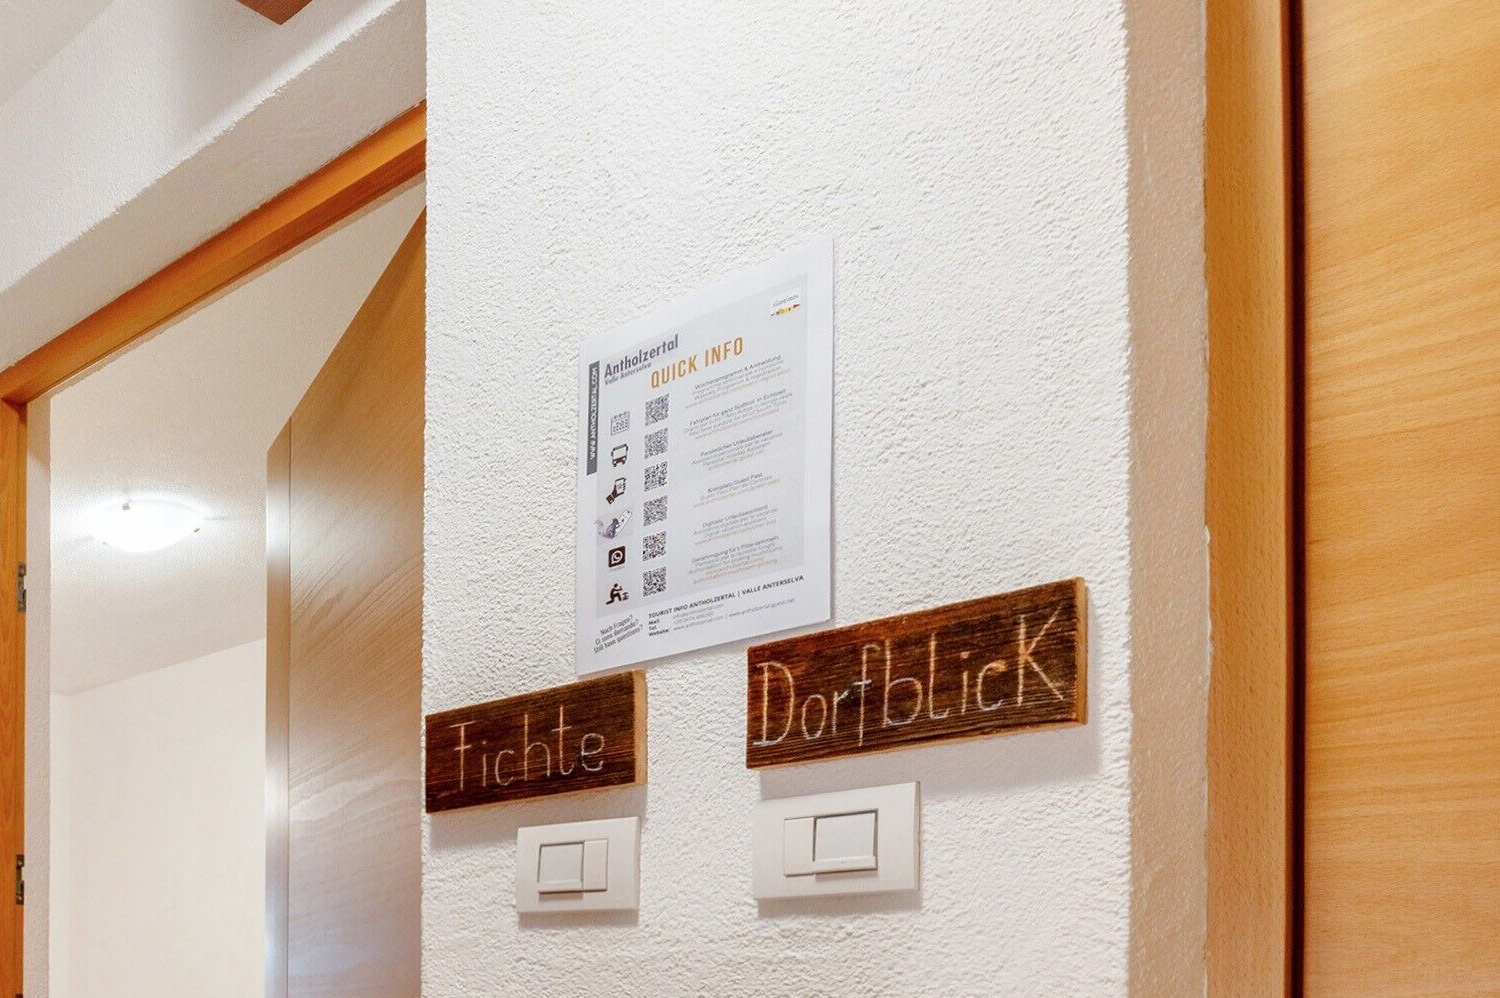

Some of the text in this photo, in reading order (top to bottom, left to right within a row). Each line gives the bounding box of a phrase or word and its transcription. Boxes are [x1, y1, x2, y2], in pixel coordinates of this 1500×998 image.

[604, 333, 678, 379] Antholzertal
[650, 354, 697, 390] QUICK
[704, 335, 743, 368] INFO
[648, 607, 671, 618] TOURIST
[673, 603, 688, 612] INFO
[688, 591, 735, 608] ANTHOLZERTAL
[741, 585, 760, 595] VALLE
[762, 574, 803, 590] ANTERSELVA
[450, 704, 606, 792] Fichte
